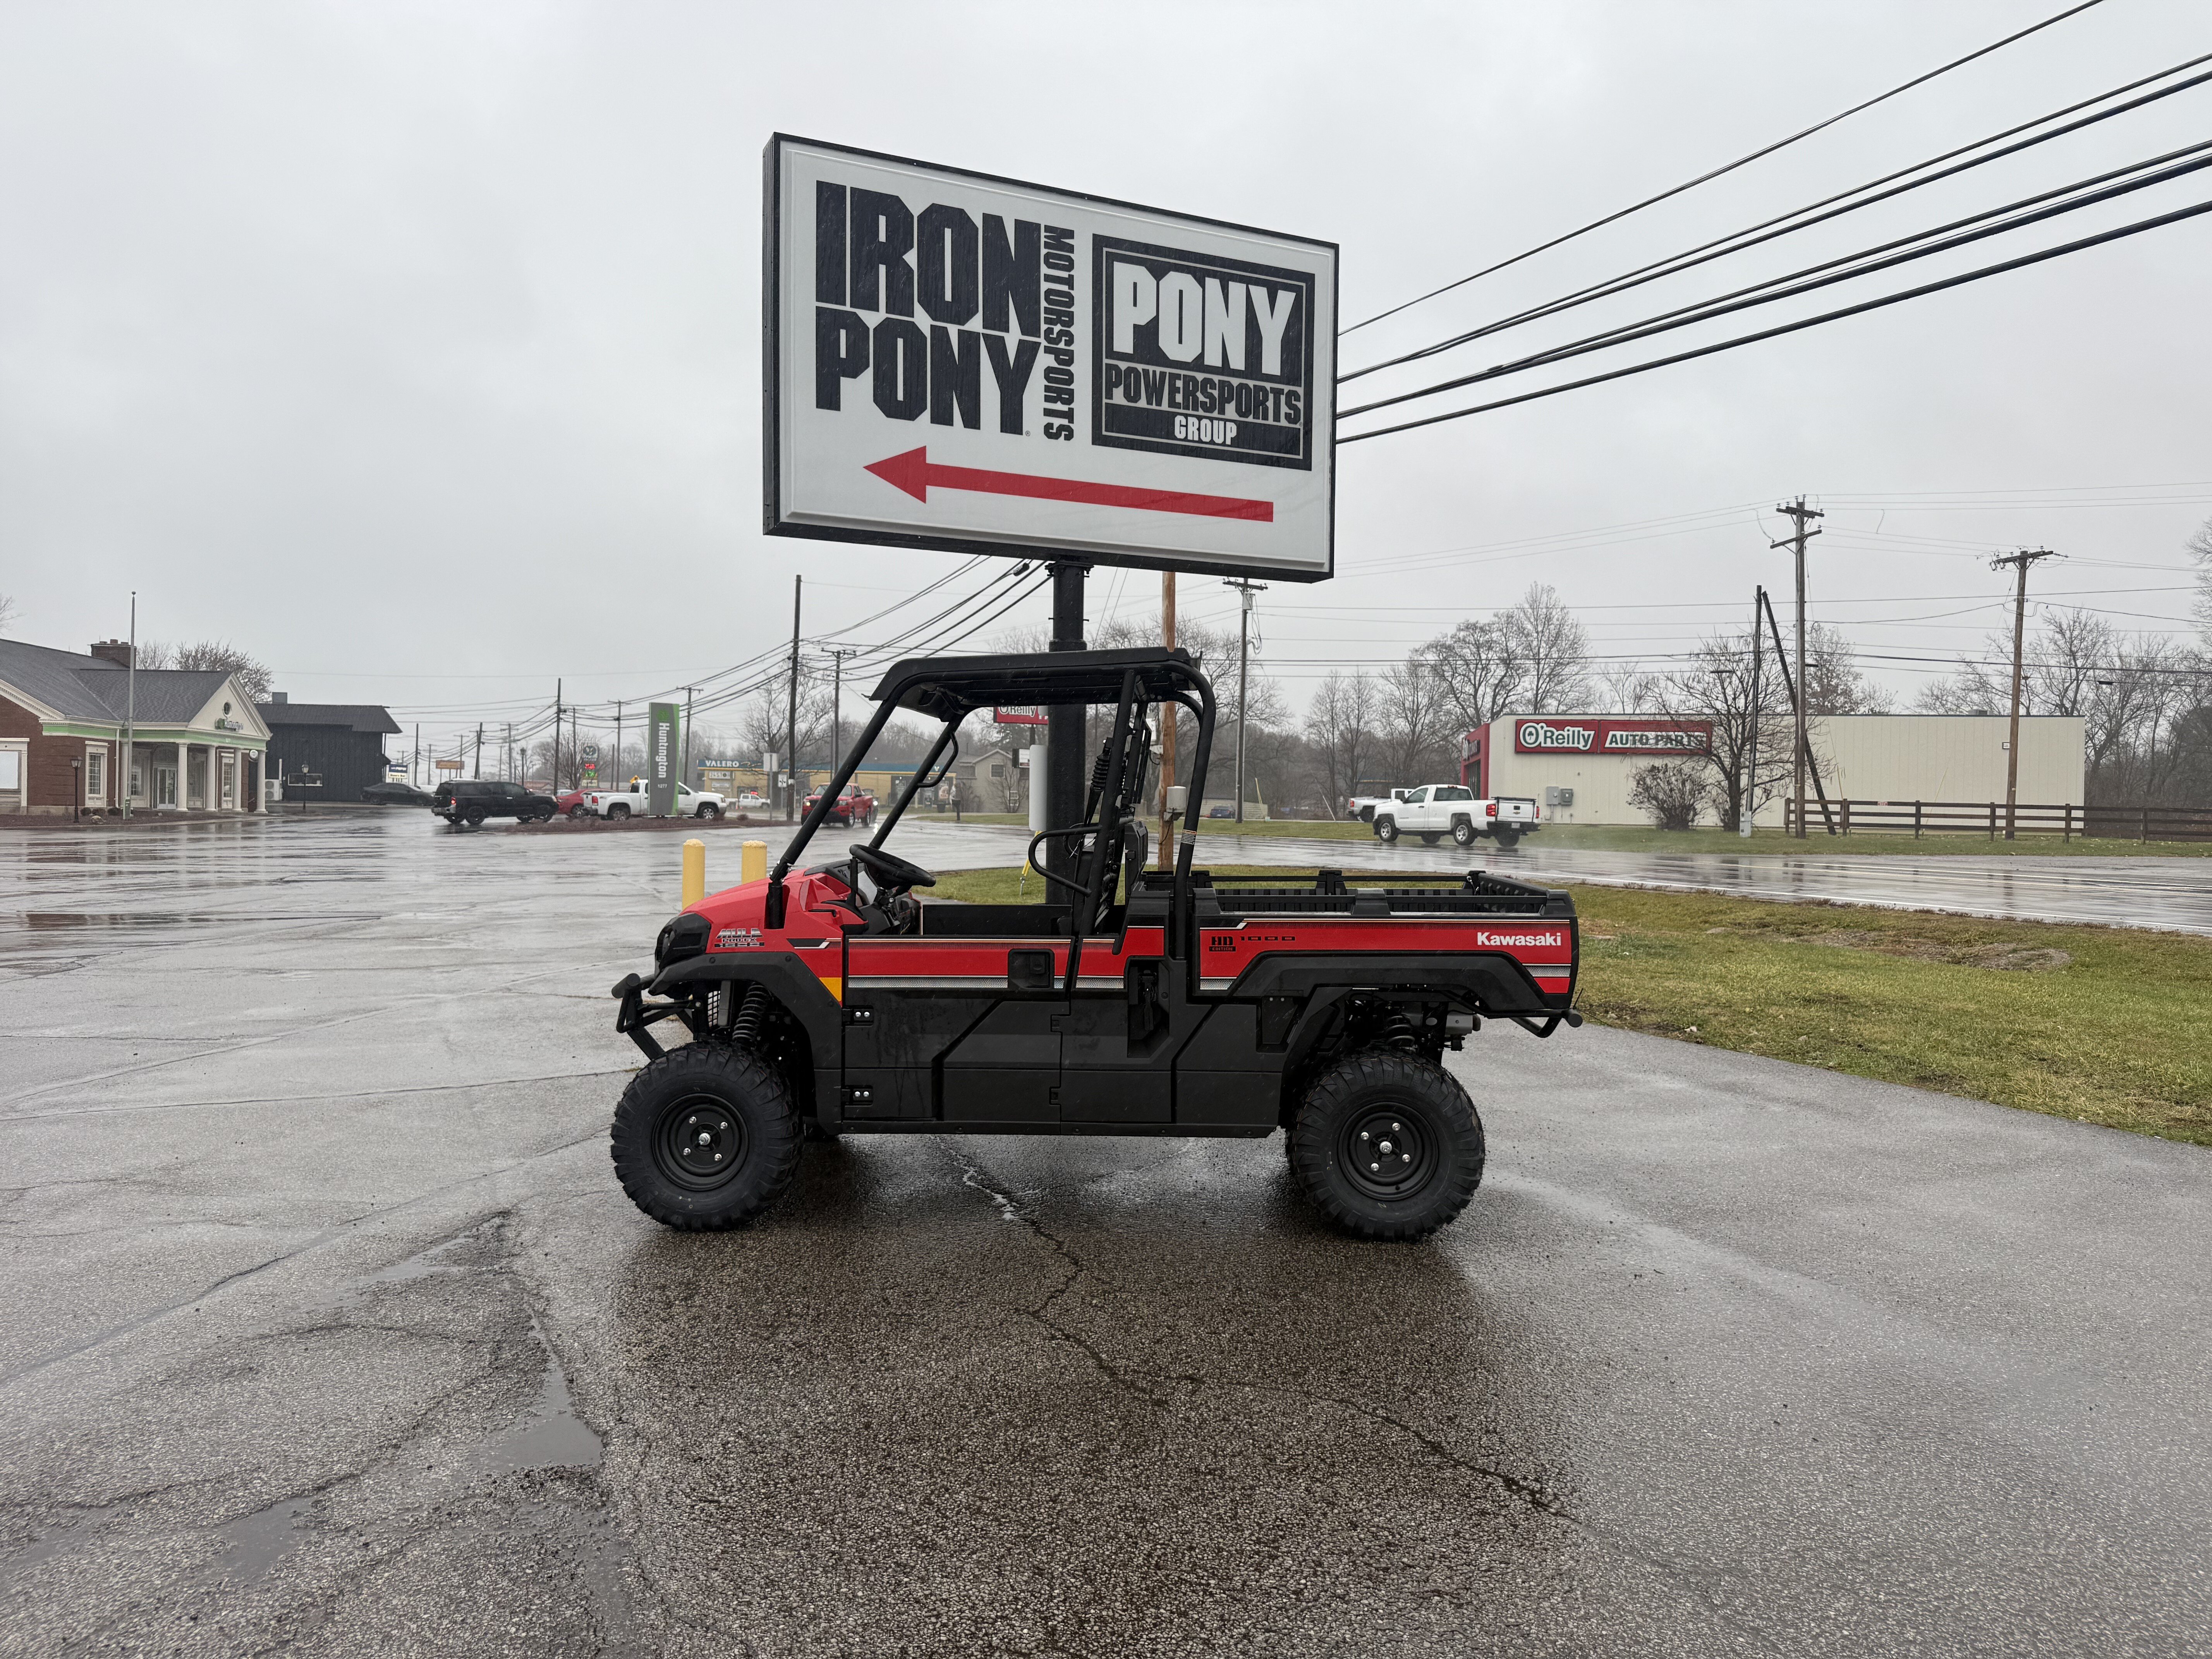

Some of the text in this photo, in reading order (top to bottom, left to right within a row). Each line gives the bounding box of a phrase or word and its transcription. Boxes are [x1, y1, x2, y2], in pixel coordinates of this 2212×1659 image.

[816, 180, 1041, 338] IRON
[1043, 225, 1074, 441] MOTORSPORTS
[1113, 261, 1296, 376] PONY
[816, 305, 1041, 436] PONY
[1105, 362, 1301, 425] POWERSPORTS
[1175, 415, 1237, 445] GROUP
[656, 722, 670, 778] Huntington
[1522, 725, 1592, 748] O'Reilly
[1609, 733, 1649, 746] AUTO
[716, 928, 763, 939] MULE
[1211, 936, 1233, 946] HD
[1477, 932, 1561, 946] Kawasaki
